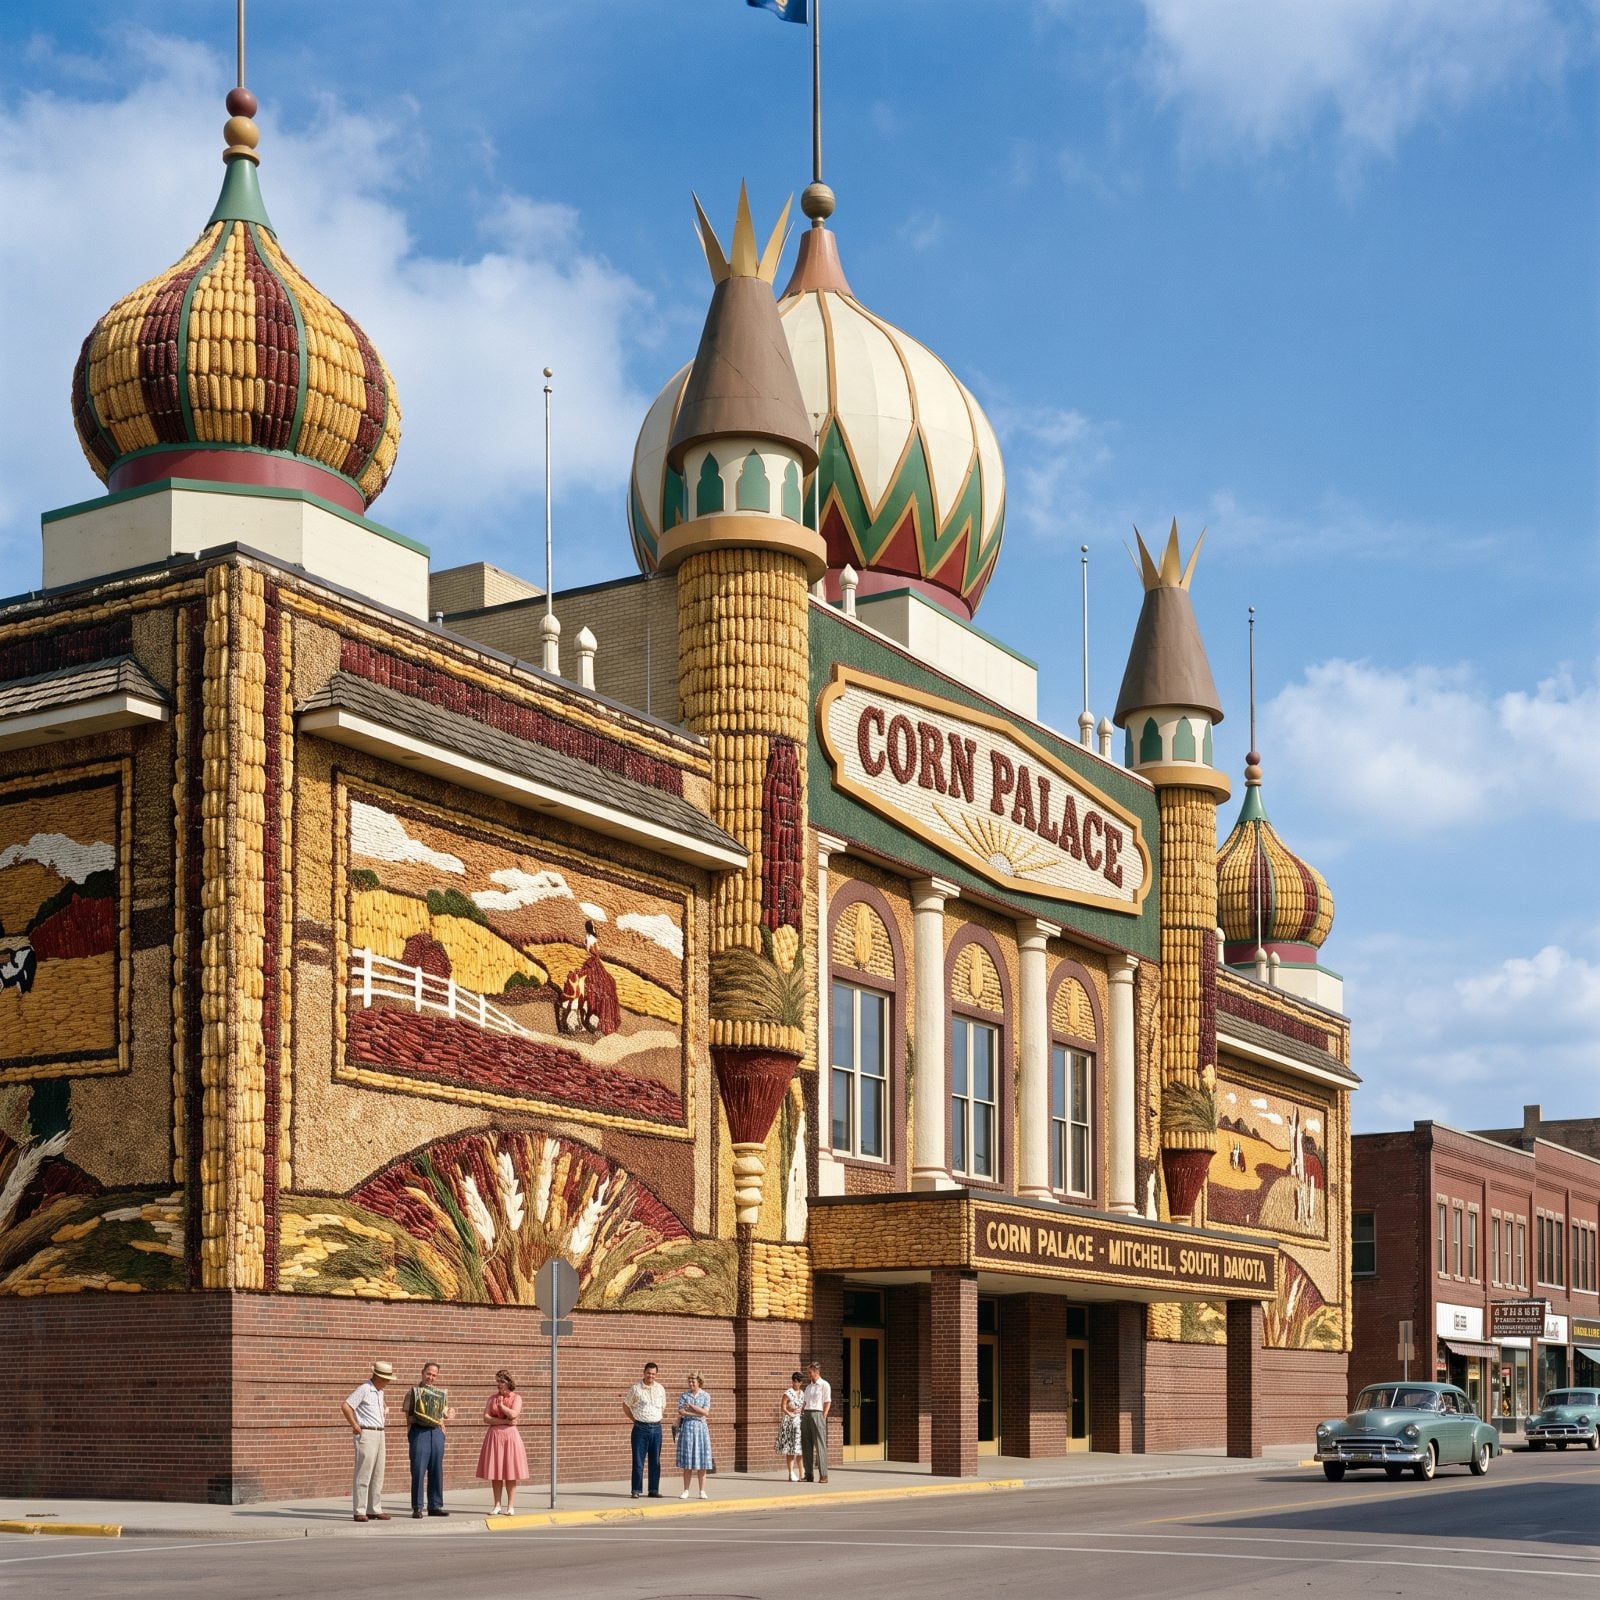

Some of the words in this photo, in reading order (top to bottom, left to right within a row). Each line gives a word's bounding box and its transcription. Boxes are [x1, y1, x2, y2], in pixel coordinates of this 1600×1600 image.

[857, 705, 977, 804] CORN
[990, 750, 1123, 889] PALACE
[986, 1221, 1031, 1254] CORN
[1038, 1228, 1094, 1262] PALACE
[1109, 1239, 1176, 1276] MITCHELL,
[1179, 1250, 1219, 1278] SOUTH
[1223, 1256, 1267, 1283] DAKOTA
